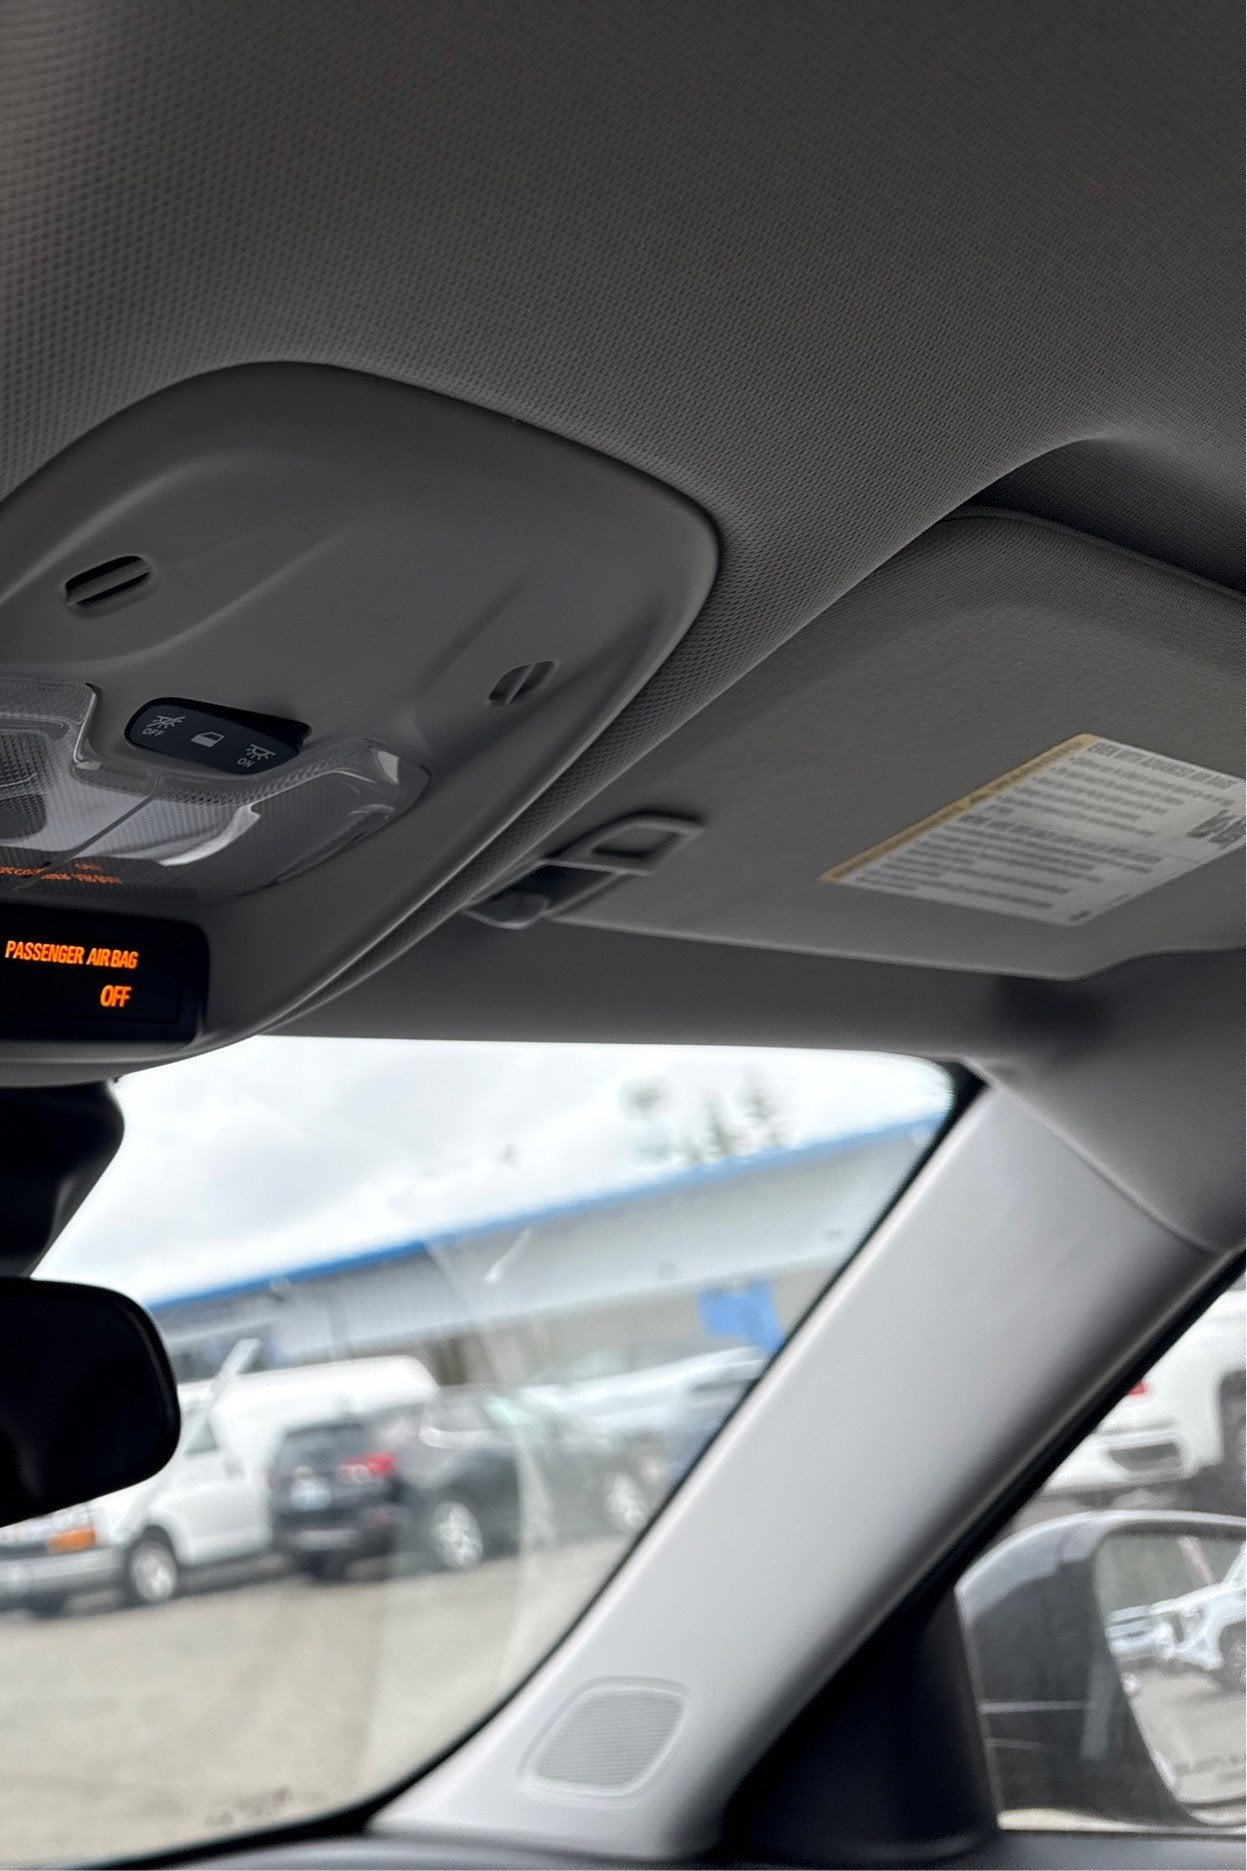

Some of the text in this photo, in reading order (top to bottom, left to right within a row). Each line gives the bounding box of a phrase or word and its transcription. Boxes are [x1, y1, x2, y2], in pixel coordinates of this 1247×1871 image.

[142, 728, 165, 738] OFF
[237, 757, 256, 769] ON
[4, 940, 86, 965] PASSENGER
[100, 984, 132, 1007] OFF
